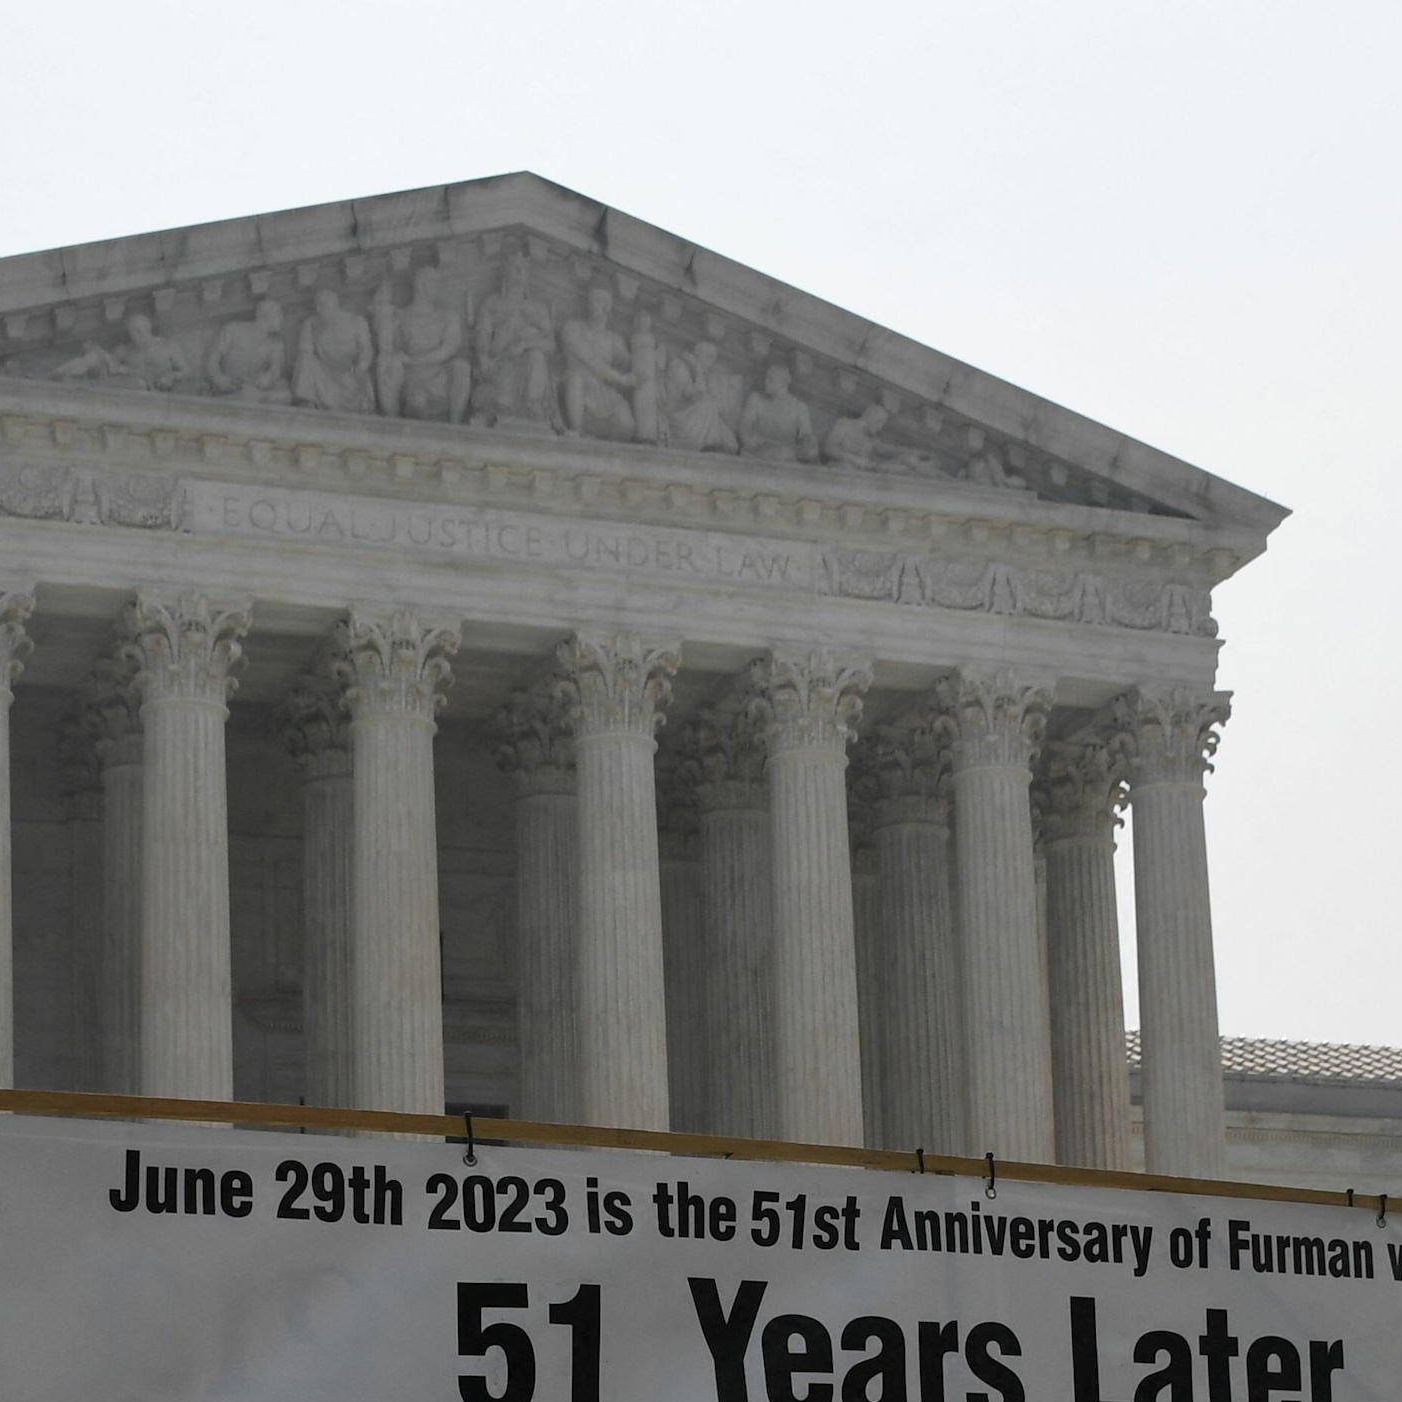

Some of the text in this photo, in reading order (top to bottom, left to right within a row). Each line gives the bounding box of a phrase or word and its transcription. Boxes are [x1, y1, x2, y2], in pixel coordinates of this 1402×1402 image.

[220, 496, 795, 582] EQUAL JUSTICE UNDER LAW
[108, 1149, 254, 1218] June
[275, 1159, 403, 1226] 29th
[425, 1172, 569, 1236] 2023
[586, 1176, 634, 1236] is
[652, 1181, 737, 1242] the
[750, 1190, 861, 1251] 51st
[880, 1195, 1153, 1278] Anniversary
[1169, 1217, 1212, 1269] of
[1228, 1219, 1375, 1279] Furman
